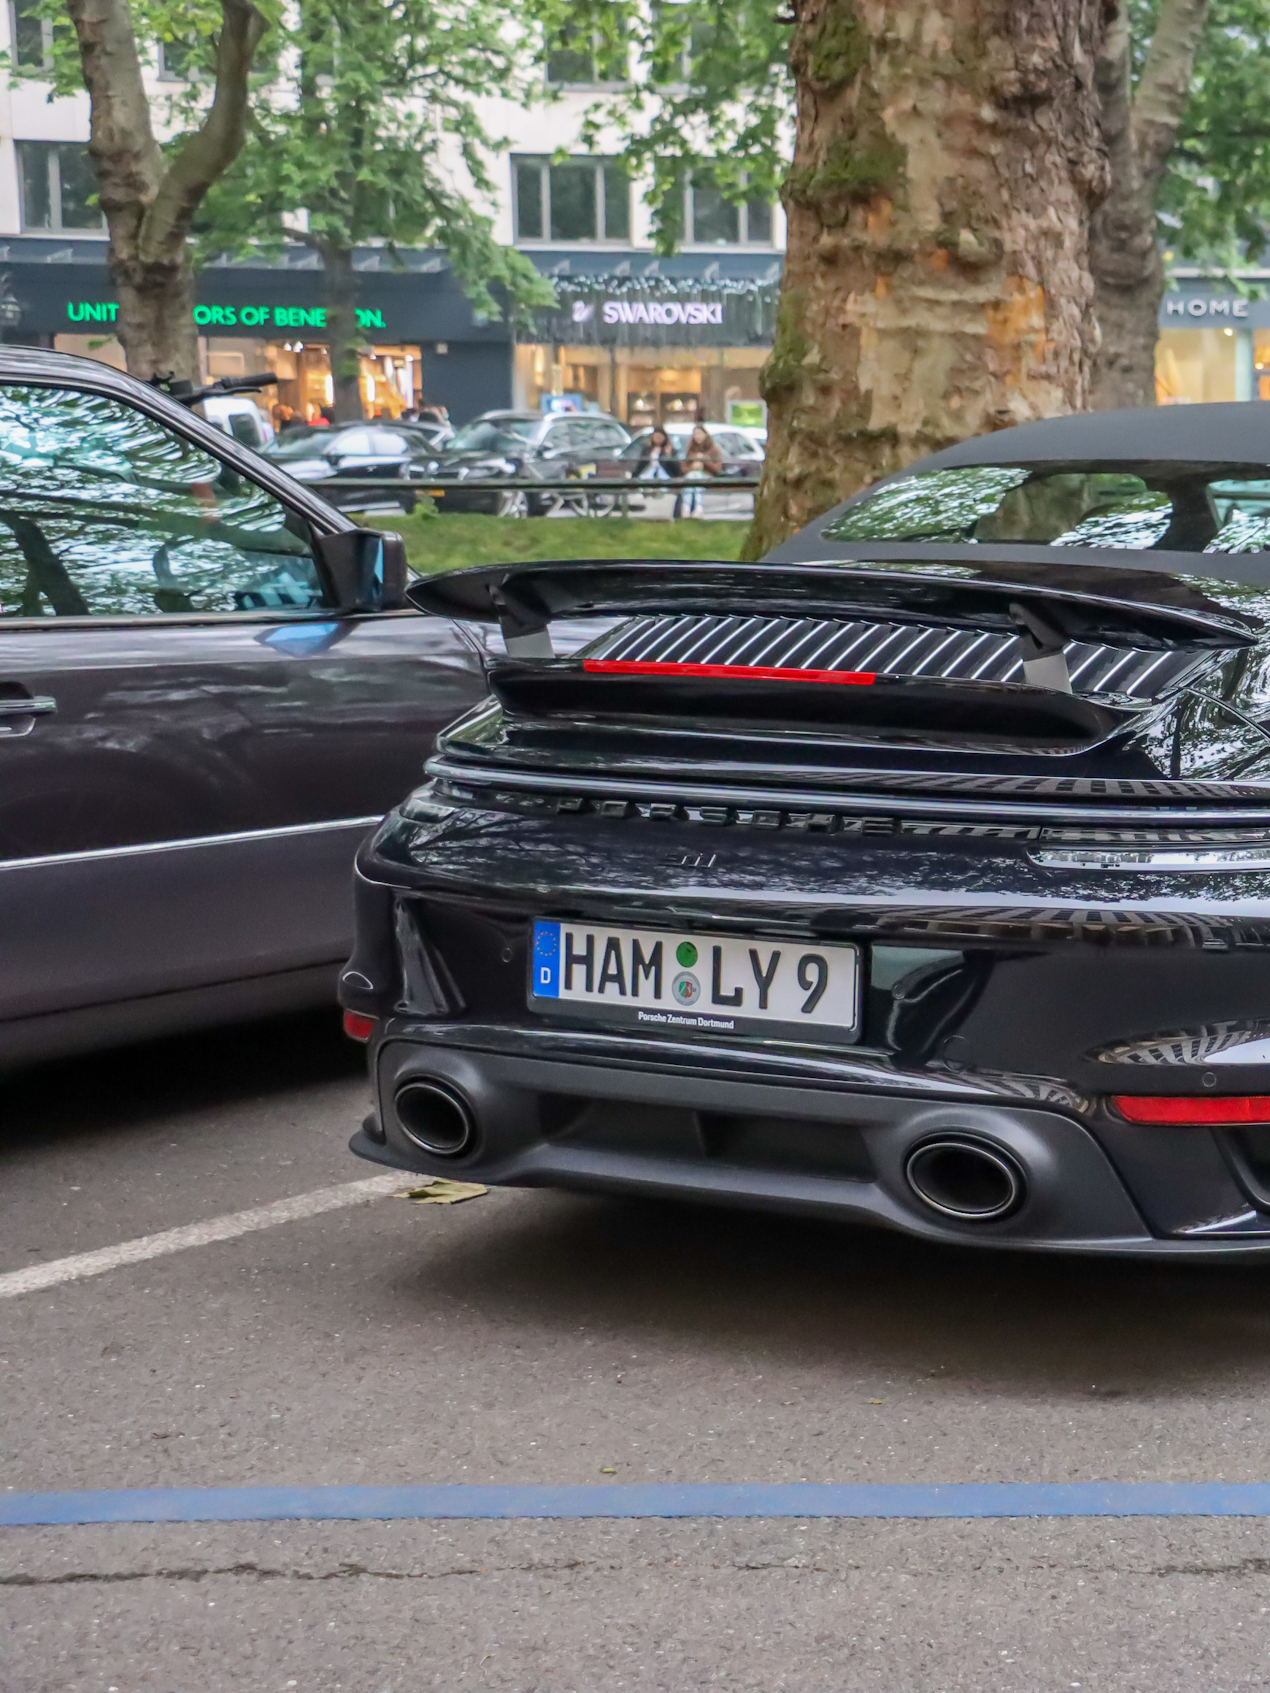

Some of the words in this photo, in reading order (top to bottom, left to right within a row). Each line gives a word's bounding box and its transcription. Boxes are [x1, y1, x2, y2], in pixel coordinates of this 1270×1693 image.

[67, 301, 119, 322] UNIT
[193, 304, 237, 326] ORS
[240, 306, 270, 326] OF
[603, 301, 723, 325] SWAROVSKI
[1166, 299, 1249, 318] HOME
[540, 967, 551, 984] D
[564, 931, 664, 1000] HAM
[711, 944, 782, 1010] LY
[797, 952, 829, 1014] 9
[638, 1011, 667, 1023] Porsche
[667, 1013, 697, 1026] Zentrum
[698, 1017, 735, 1030] Dortmund
